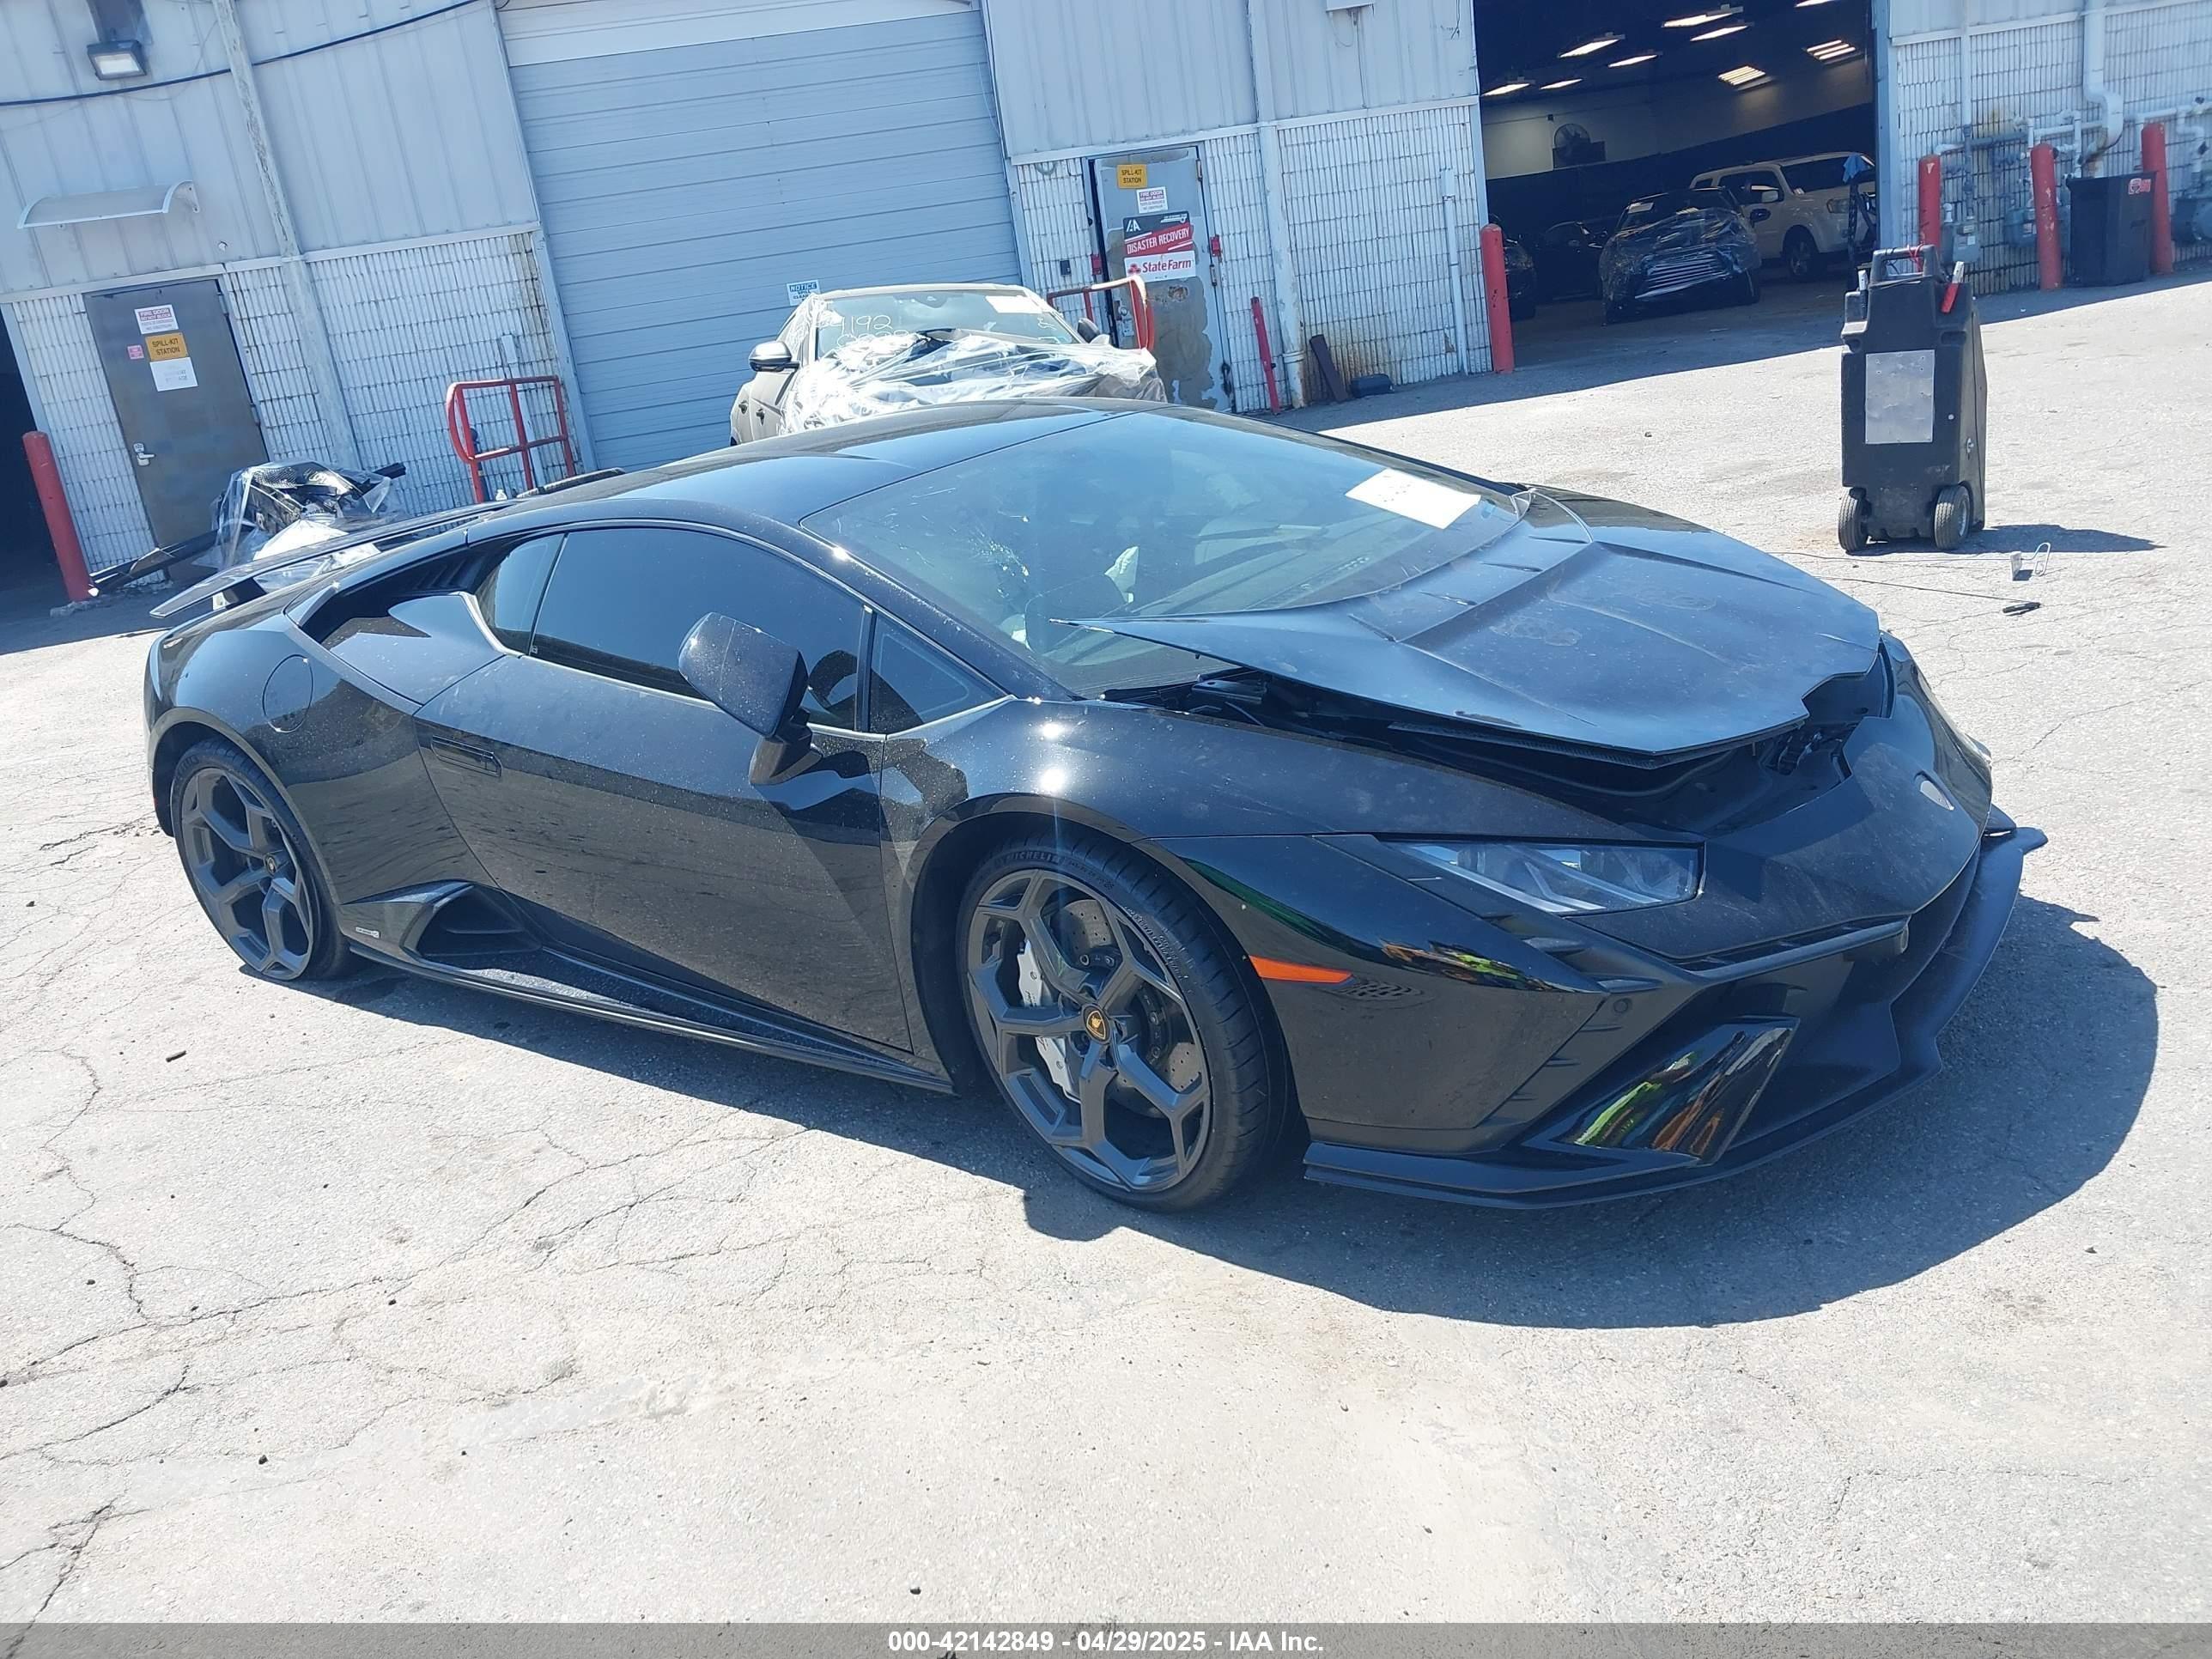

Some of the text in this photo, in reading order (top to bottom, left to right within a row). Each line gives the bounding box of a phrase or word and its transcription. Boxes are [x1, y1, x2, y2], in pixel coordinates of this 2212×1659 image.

[1127, 228, 1189, 254] DISASTER RECOVERY
[790, 282, 817, 292] NOTICE
[152, 338, 179, 347] SPILL-KIT
